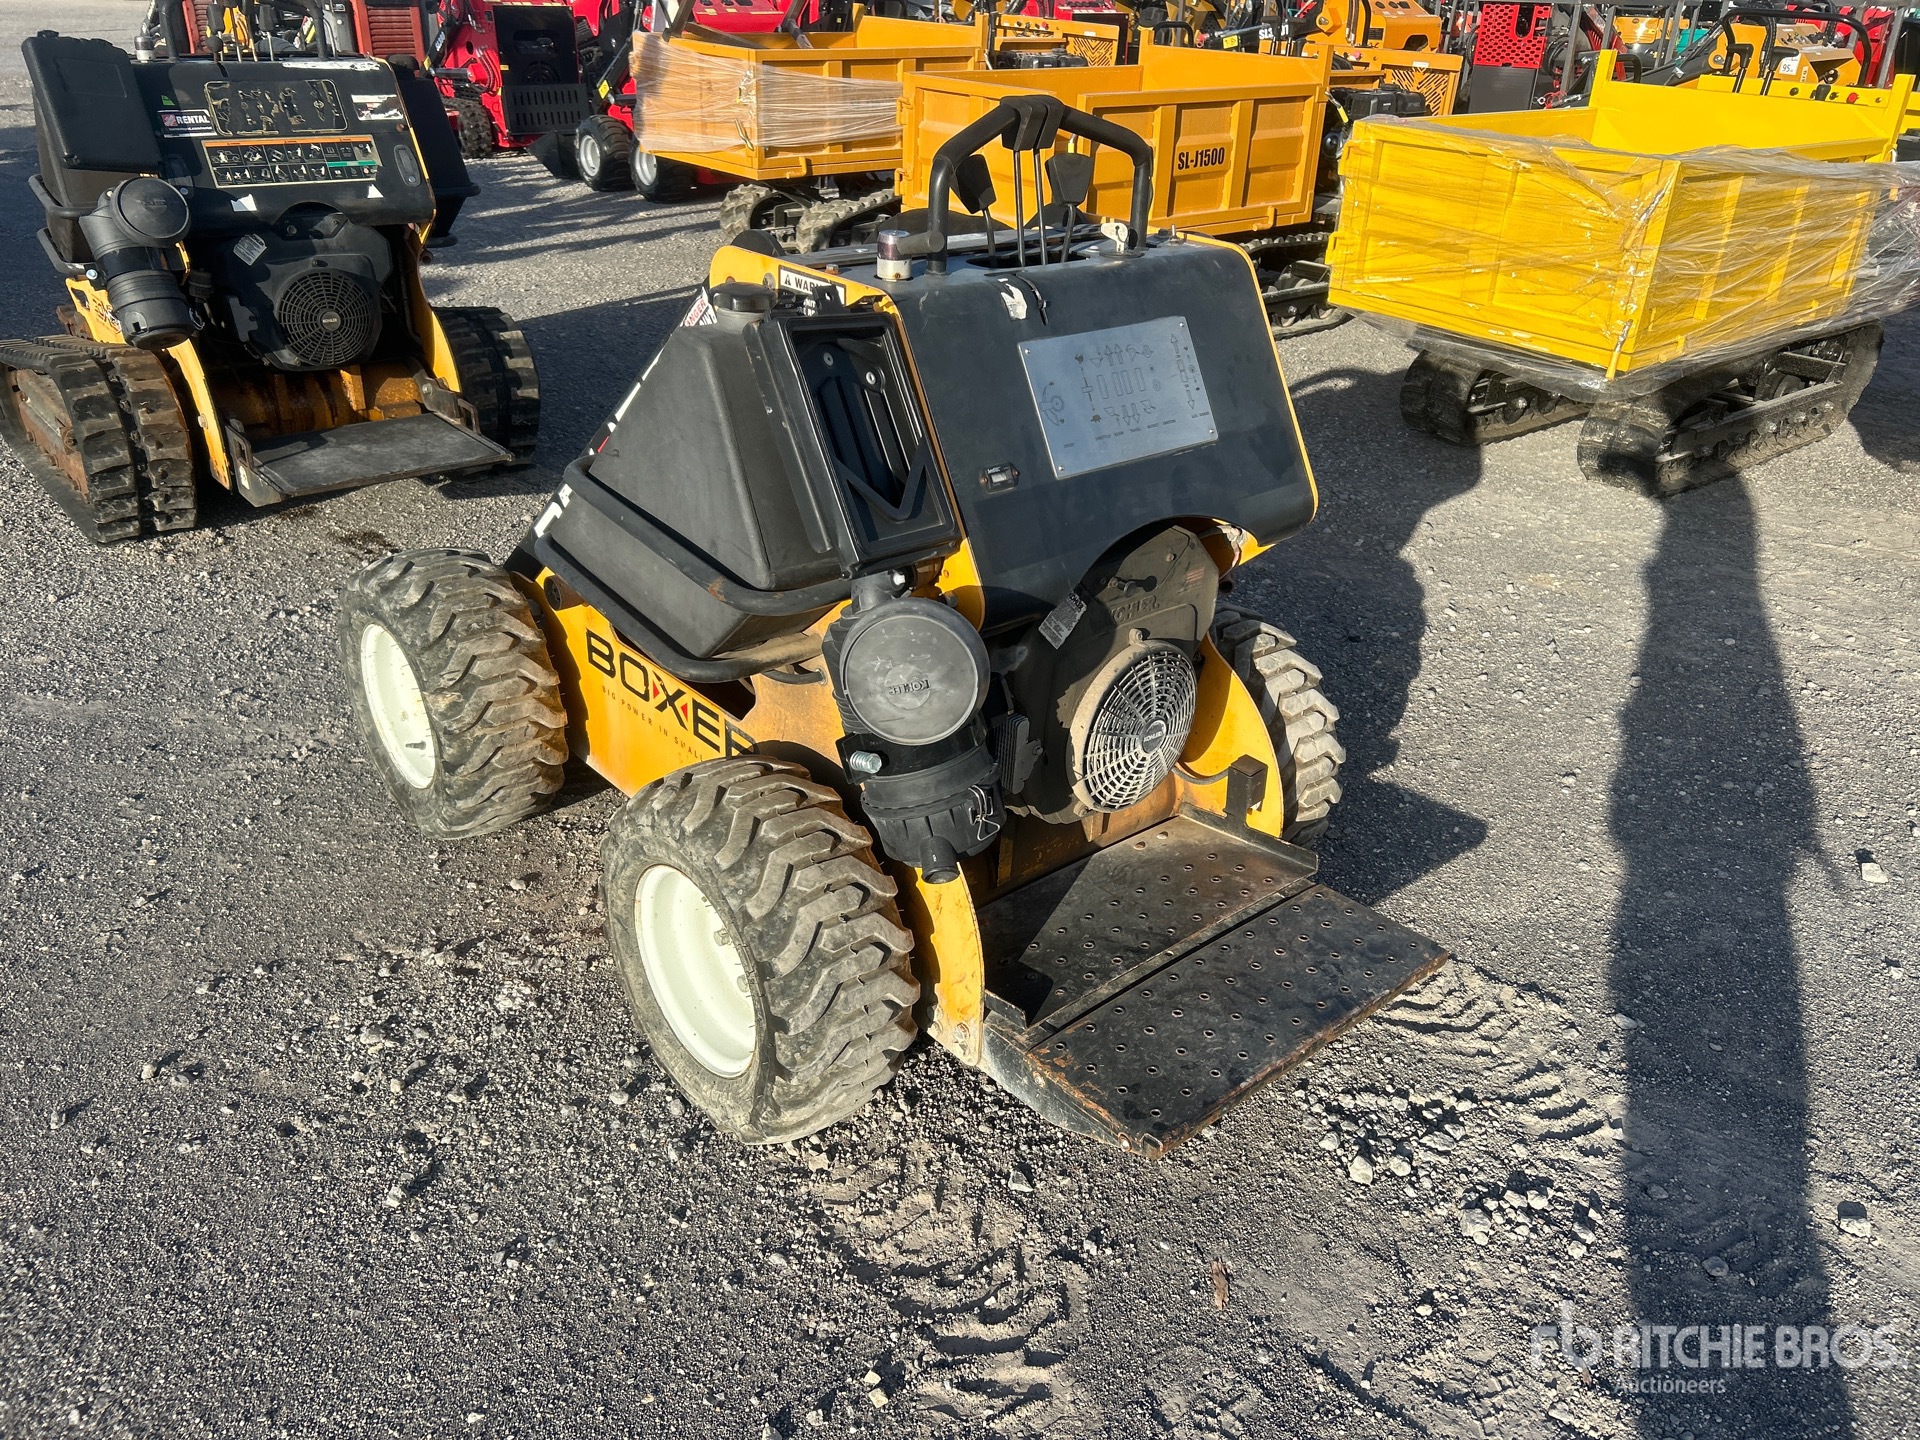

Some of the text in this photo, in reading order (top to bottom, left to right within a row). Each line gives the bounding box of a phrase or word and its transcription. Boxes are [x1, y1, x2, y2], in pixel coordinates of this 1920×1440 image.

[175, 115, 210, 125] RENTAL
[1177, 146, 1226, 171] SL-J1500
[585, 627, 761, 760] BOXER
[888, 679, 931, 696] KOHLER
[601, 685, 617, 700] BIG
[621, 698, 653, 727] POWER
[658, 724, 668, 737] IN
